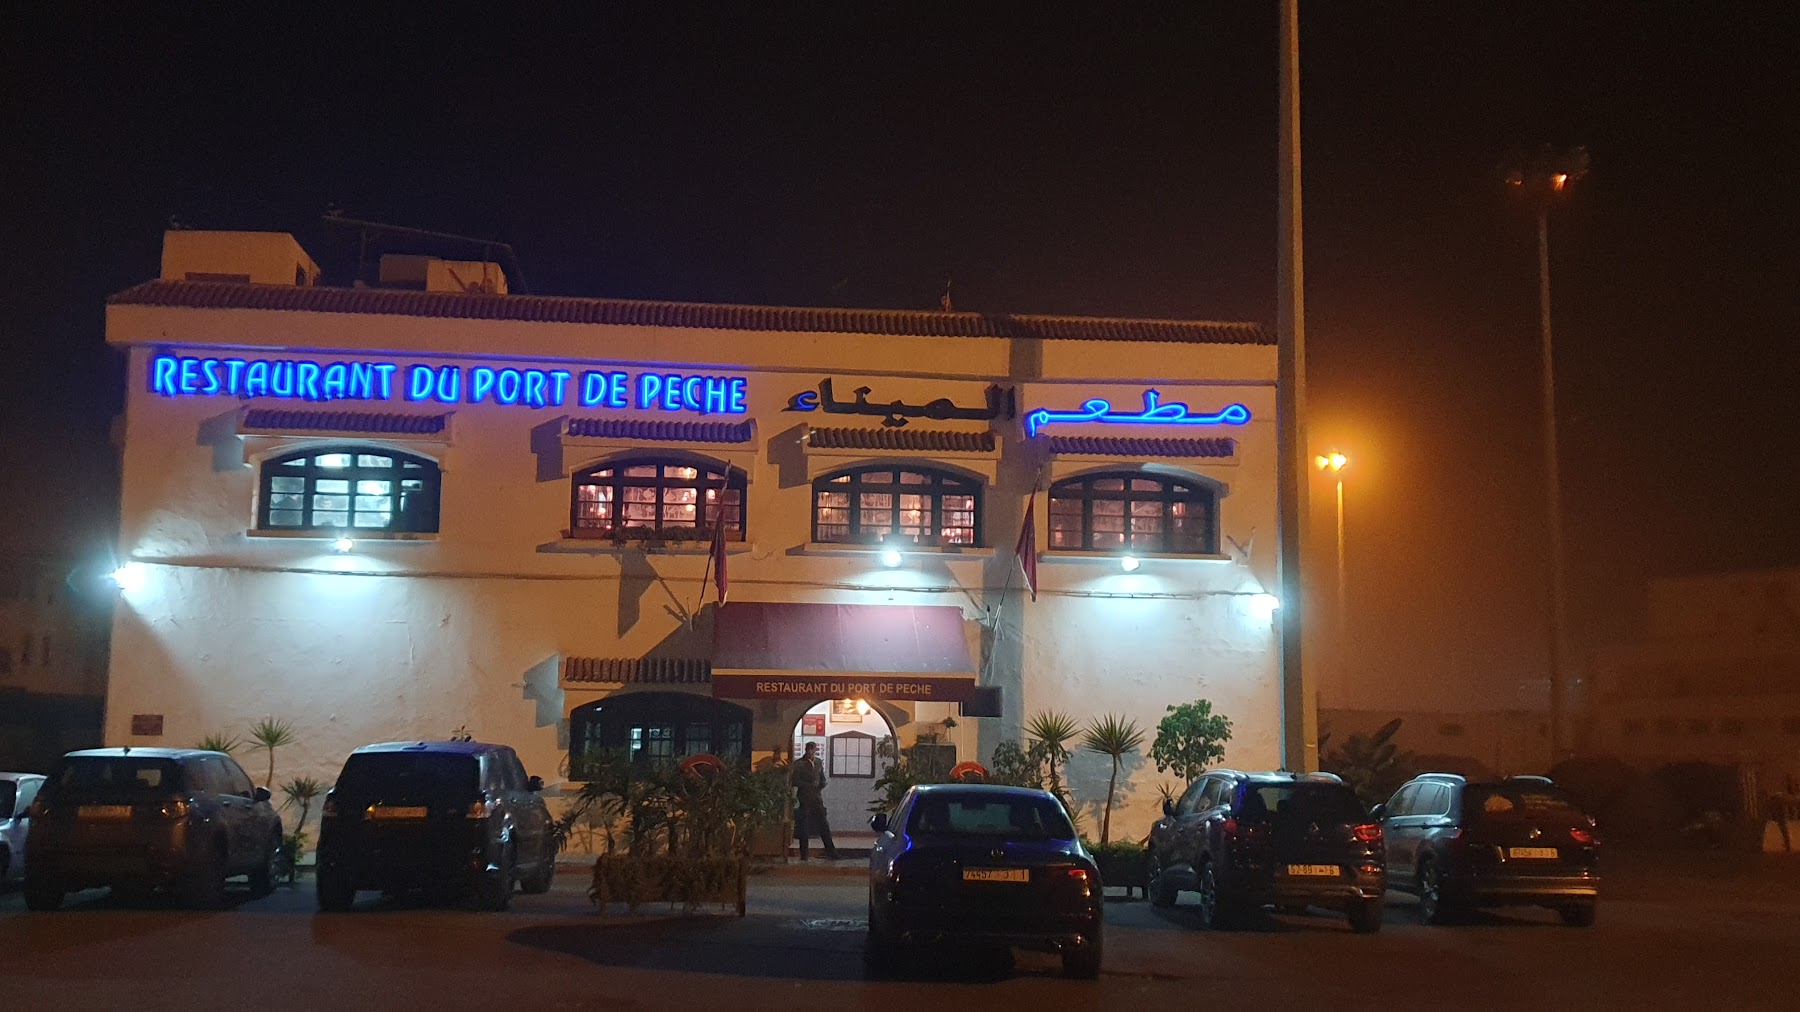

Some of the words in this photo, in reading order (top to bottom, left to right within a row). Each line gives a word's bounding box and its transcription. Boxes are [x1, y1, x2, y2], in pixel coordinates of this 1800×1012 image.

[154, 357, 396, 400] RESTAURANT
[407, 365, 460, 404] DU
[472, 367, 571, 408] PORT
[583, 371, 630, 410] DE
[639, 374, 747, 414] PECHE
[1026, 388, 1251, 437] مطعم
[756, 682, 828, 694] RESTAURANT
[831, 683, 845, 694] DU
[848, 683, 876, 694] PORT
[879, 684, 894, 694] DE
[896, 684, 932, 695] PECHE
